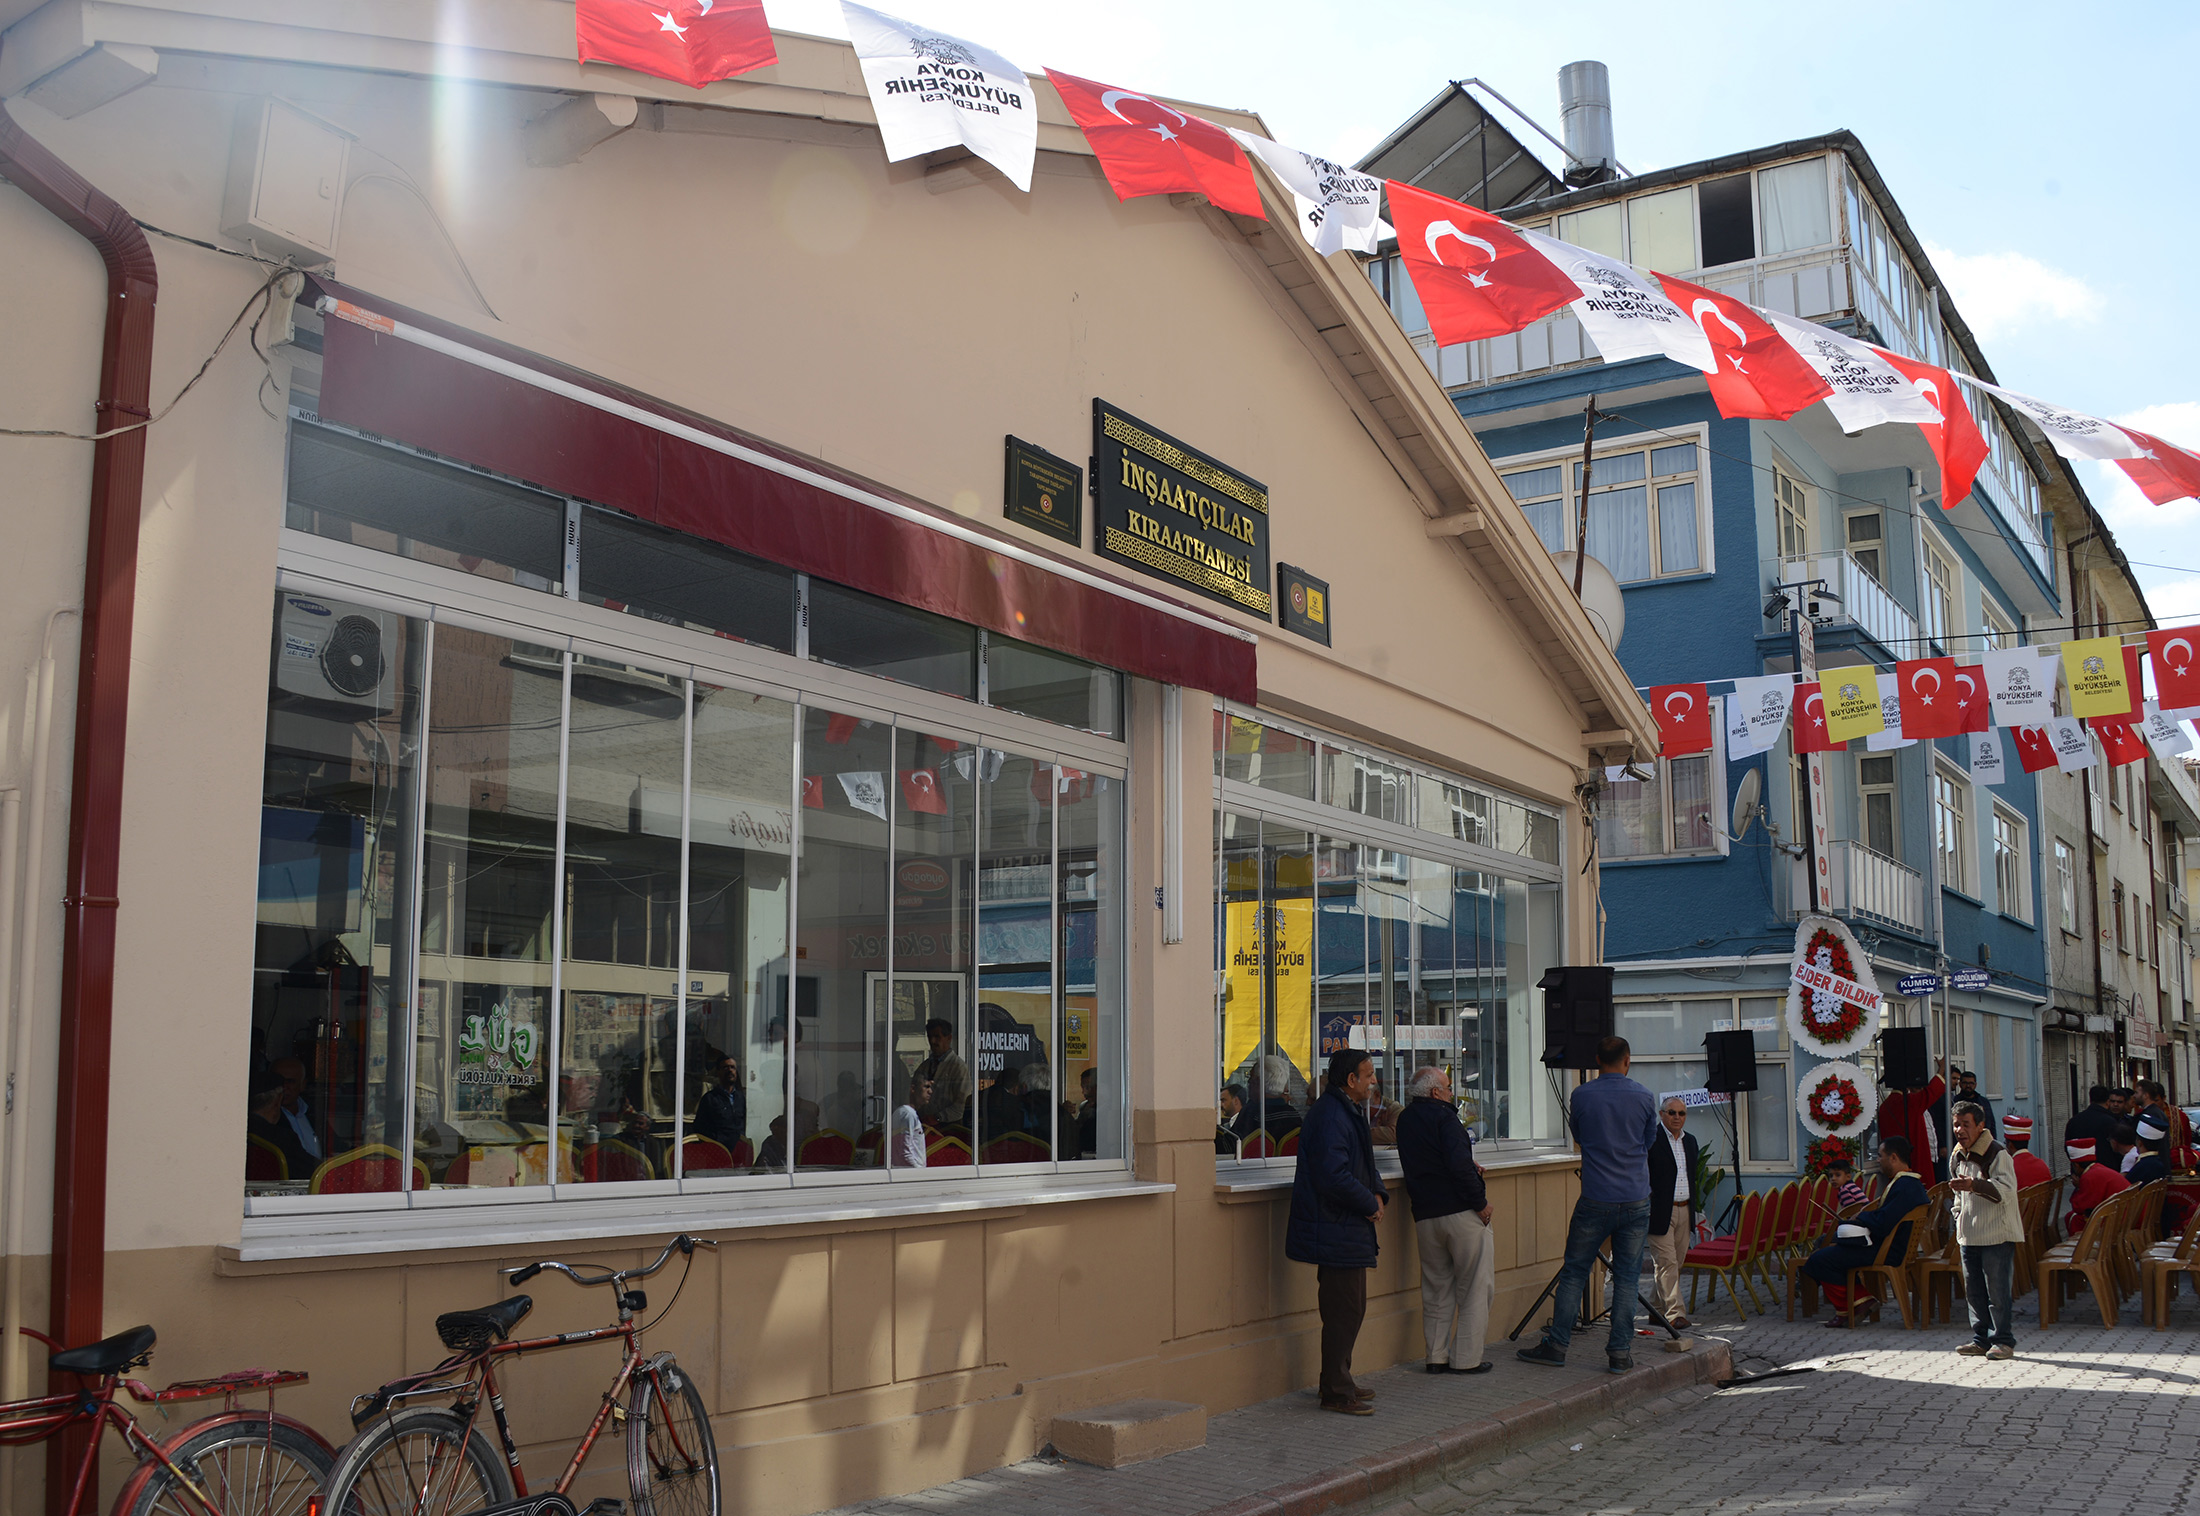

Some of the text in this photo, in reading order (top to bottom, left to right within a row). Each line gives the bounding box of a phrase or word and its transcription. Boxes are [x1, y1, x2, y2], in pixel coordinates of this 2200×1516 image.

[1121, 448, 1256, 546] İNŞAATÇILAR
[1128, 509, 1252, 584] KIRAATHANESİ
[2084, 674, 2108, 682] KONYA
[2074, 680, 2122, 691] BÜYÜKŞEHİR
[1996, 690, 2043, 700] BÜYÜKŞEHİR
[2084, 688, 2113, 696] BELEDİYESİ
[1841, 699, 1864, 707] KONYA
[1830, 703, 1878, 718] BÜYÜKŞEHİR
[1751, 711, 1783, 724] BÜYÜKŞE
[1795, 965, 1830, 991] EJDER
[1900, 978, 1936, 988] KUMRU
[978, 1032, 1030, 1051] HANELERİN
